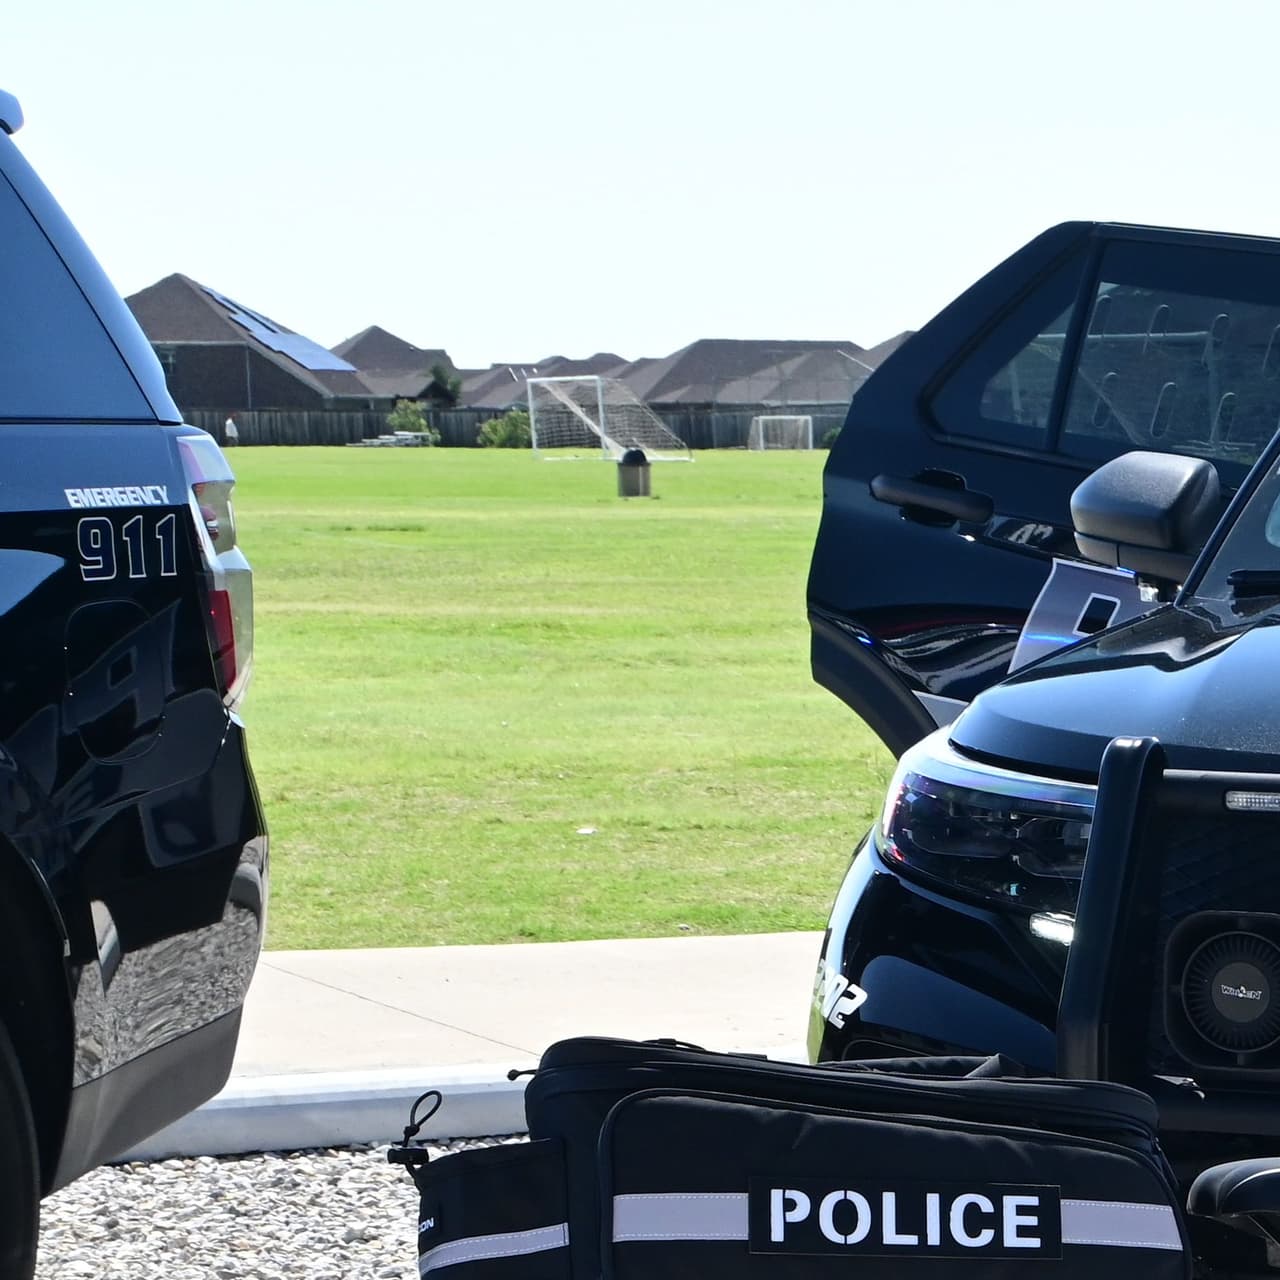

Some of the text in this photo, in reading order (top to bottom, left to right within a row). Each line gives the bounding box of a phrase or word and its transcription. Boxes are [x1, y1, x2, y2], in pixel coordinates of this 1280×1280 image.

[64, 485, 169, 508] EMERGENCY
[77, 514, 177, 581] 911
[770, 1188, 1042, 1249] POLICE
